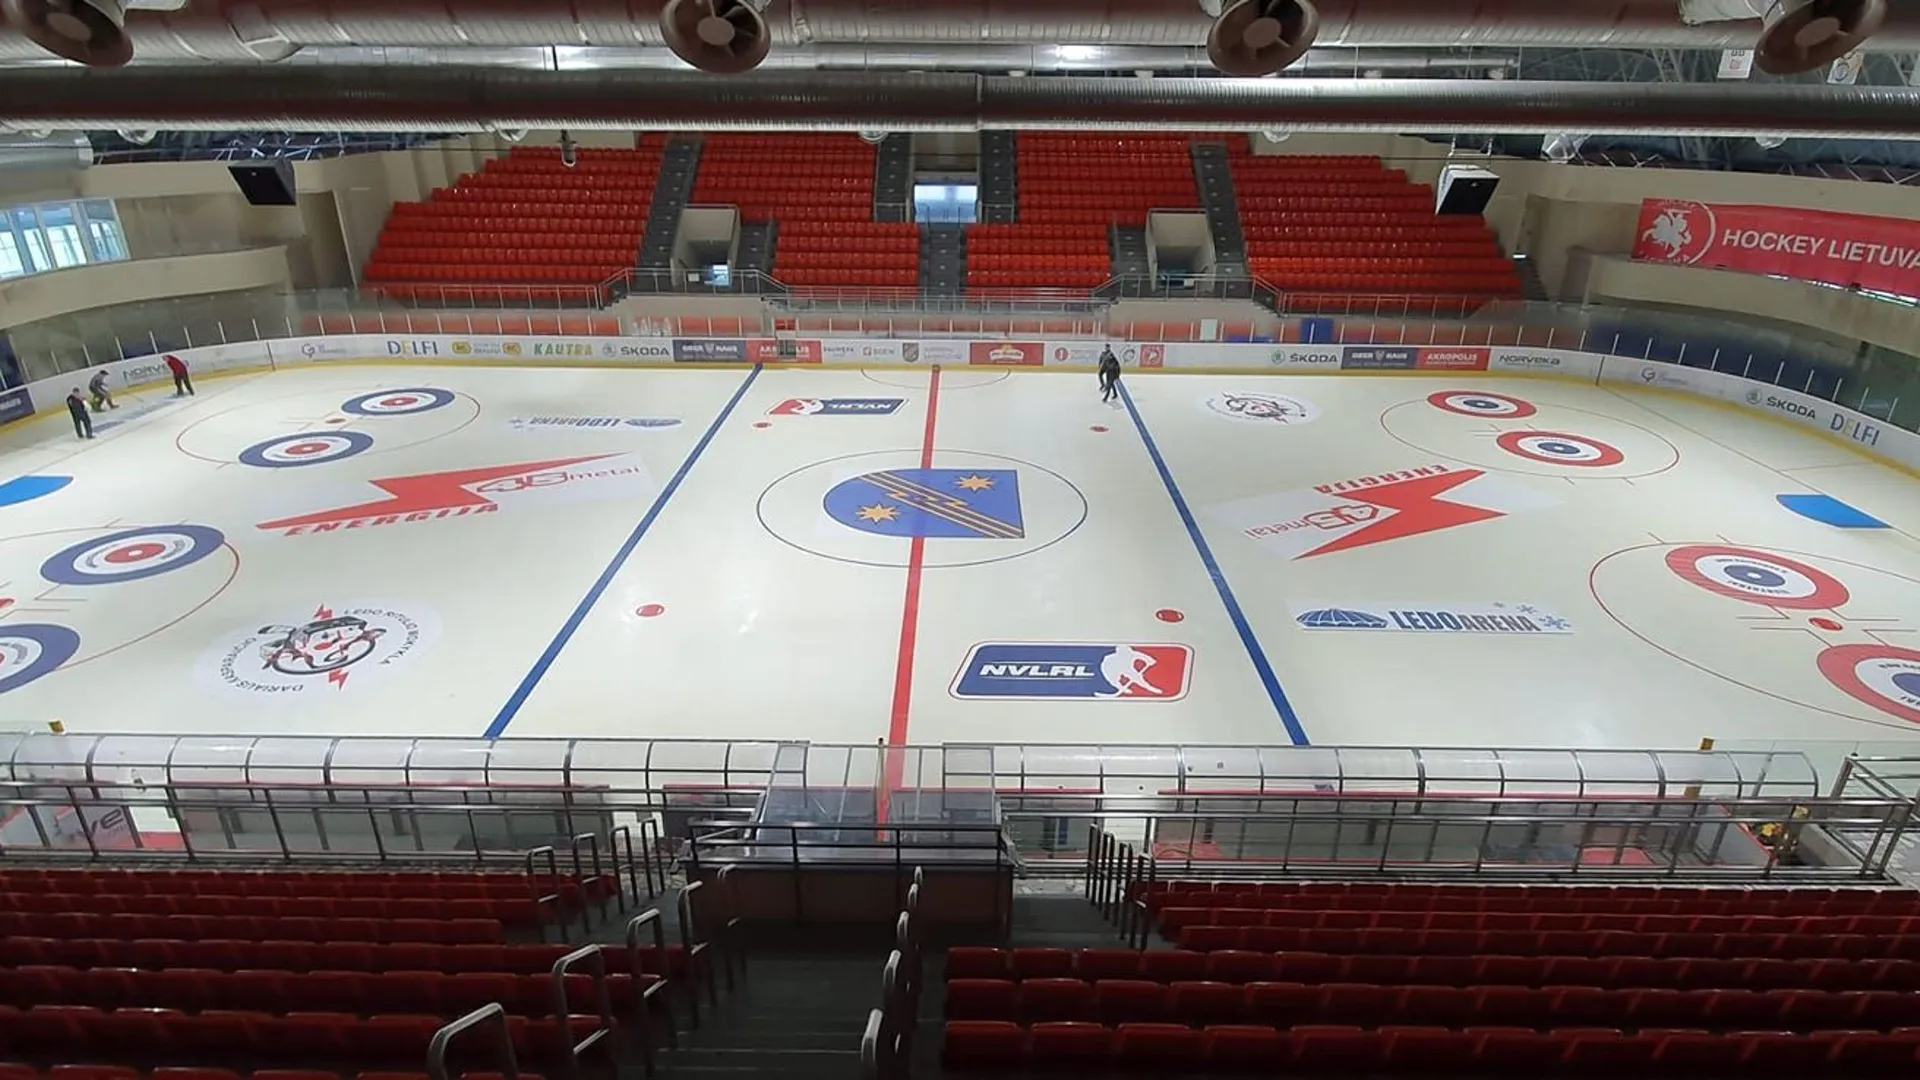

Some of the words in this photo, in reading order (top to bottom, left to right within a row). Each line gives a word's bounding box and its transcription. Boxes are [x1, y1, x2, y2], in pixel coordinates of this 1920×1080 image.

[1722, 229, 1824, 256] HOCKEY
[387, 340, 439, 355] DELFI
[534, 343, 593, 355] KAUTRA
[1830, 412, 1881, 446] DELFI
[1313, 464, 1449, 494] ENERGIJA
[283, 502, 499, 537] ENERGIJA
[979, 664, 1095, 676] NVLRL
